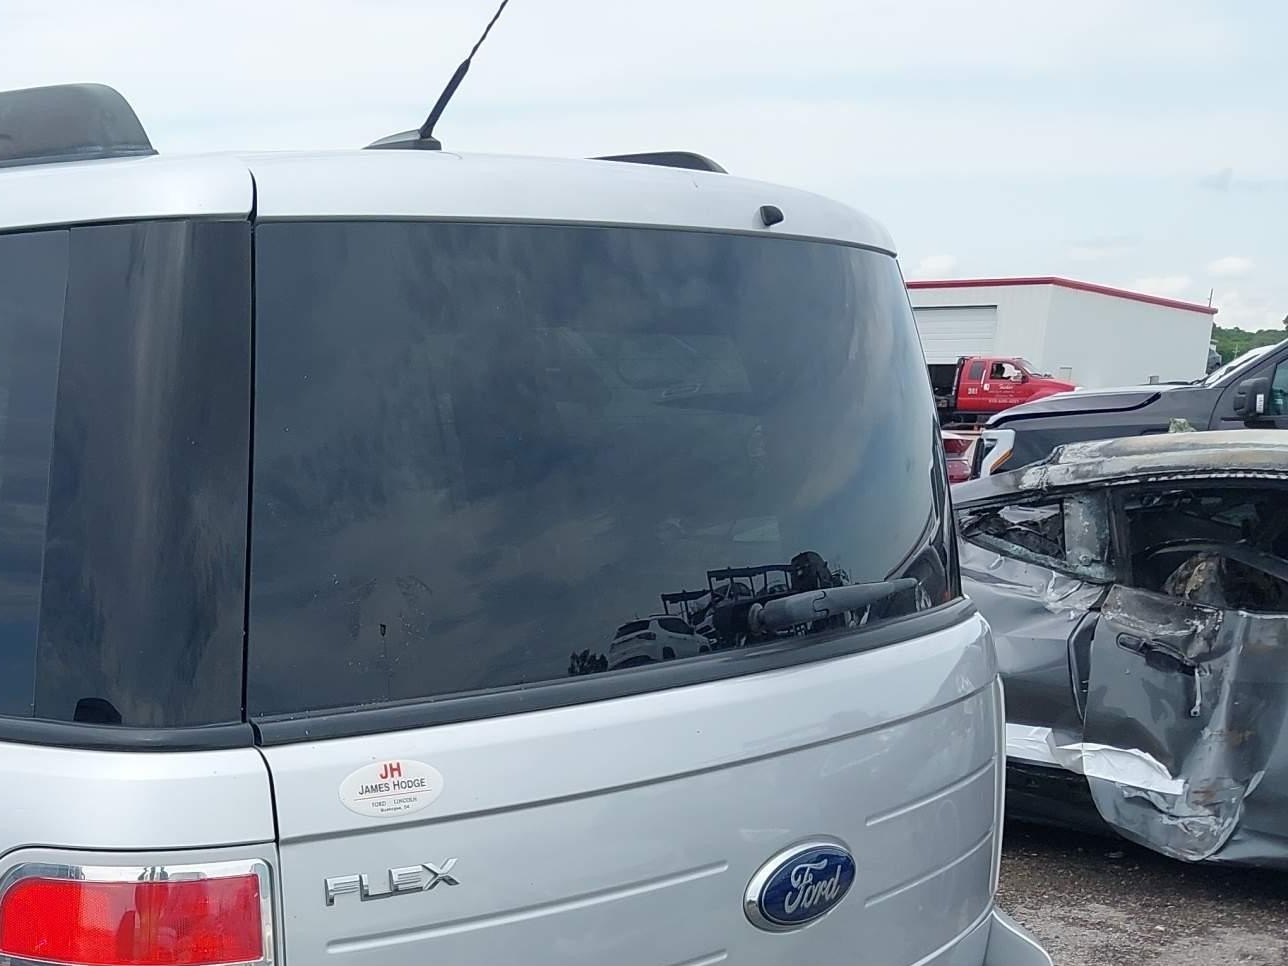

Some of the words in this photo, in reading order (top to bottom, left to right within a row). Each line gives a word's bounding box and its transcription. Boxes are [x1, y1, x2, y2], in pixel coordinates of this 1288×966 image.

[358, 782, 390, 795] JAMES
[393, 778, 426, 790] HODGE
[379, 762, 402, 779] JH
[324, 858, 460, 906] FLEX
[784, 858, 842, 914] Ford
